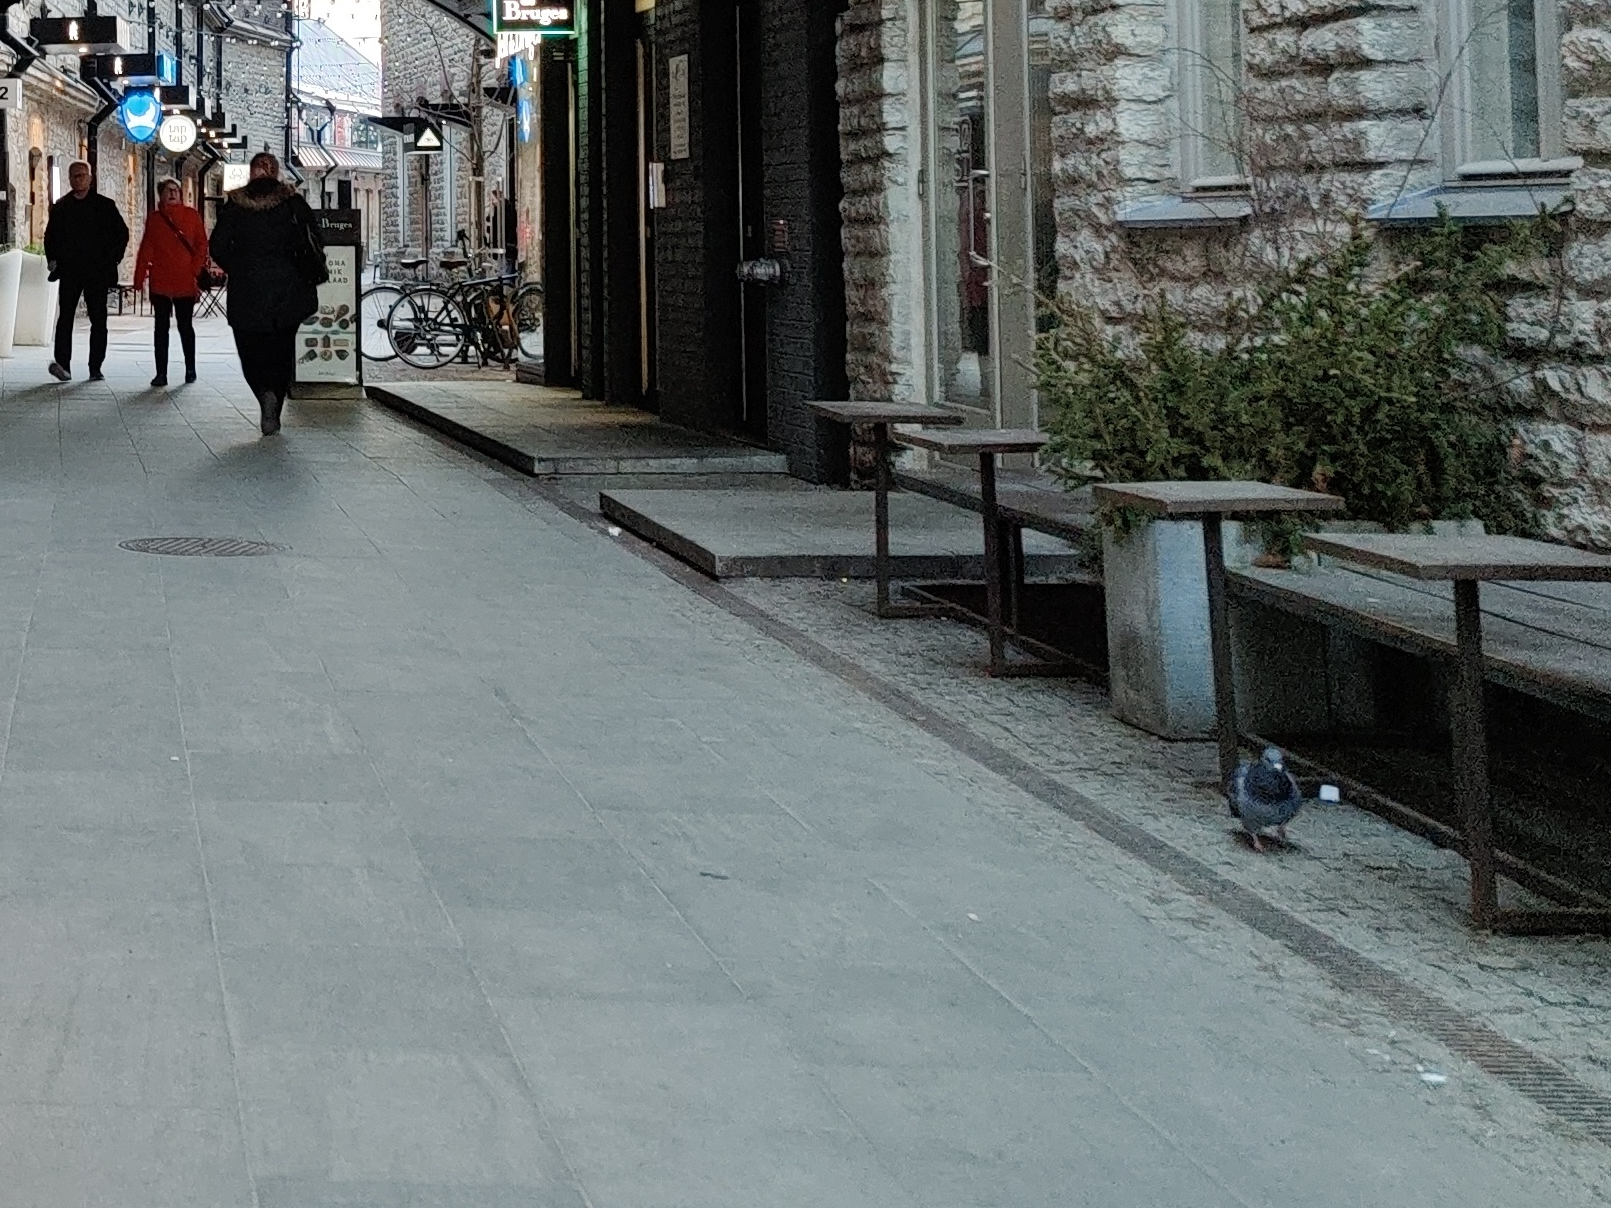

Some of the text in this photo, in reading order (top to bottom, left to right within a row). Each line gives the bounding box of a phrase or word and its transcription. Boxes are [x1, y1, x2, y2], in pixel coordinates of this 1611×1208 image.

[502, 0, 569, 26] Bruges
[169, 125, 187, 135] tap
[169, 134, 188, 145] tap
